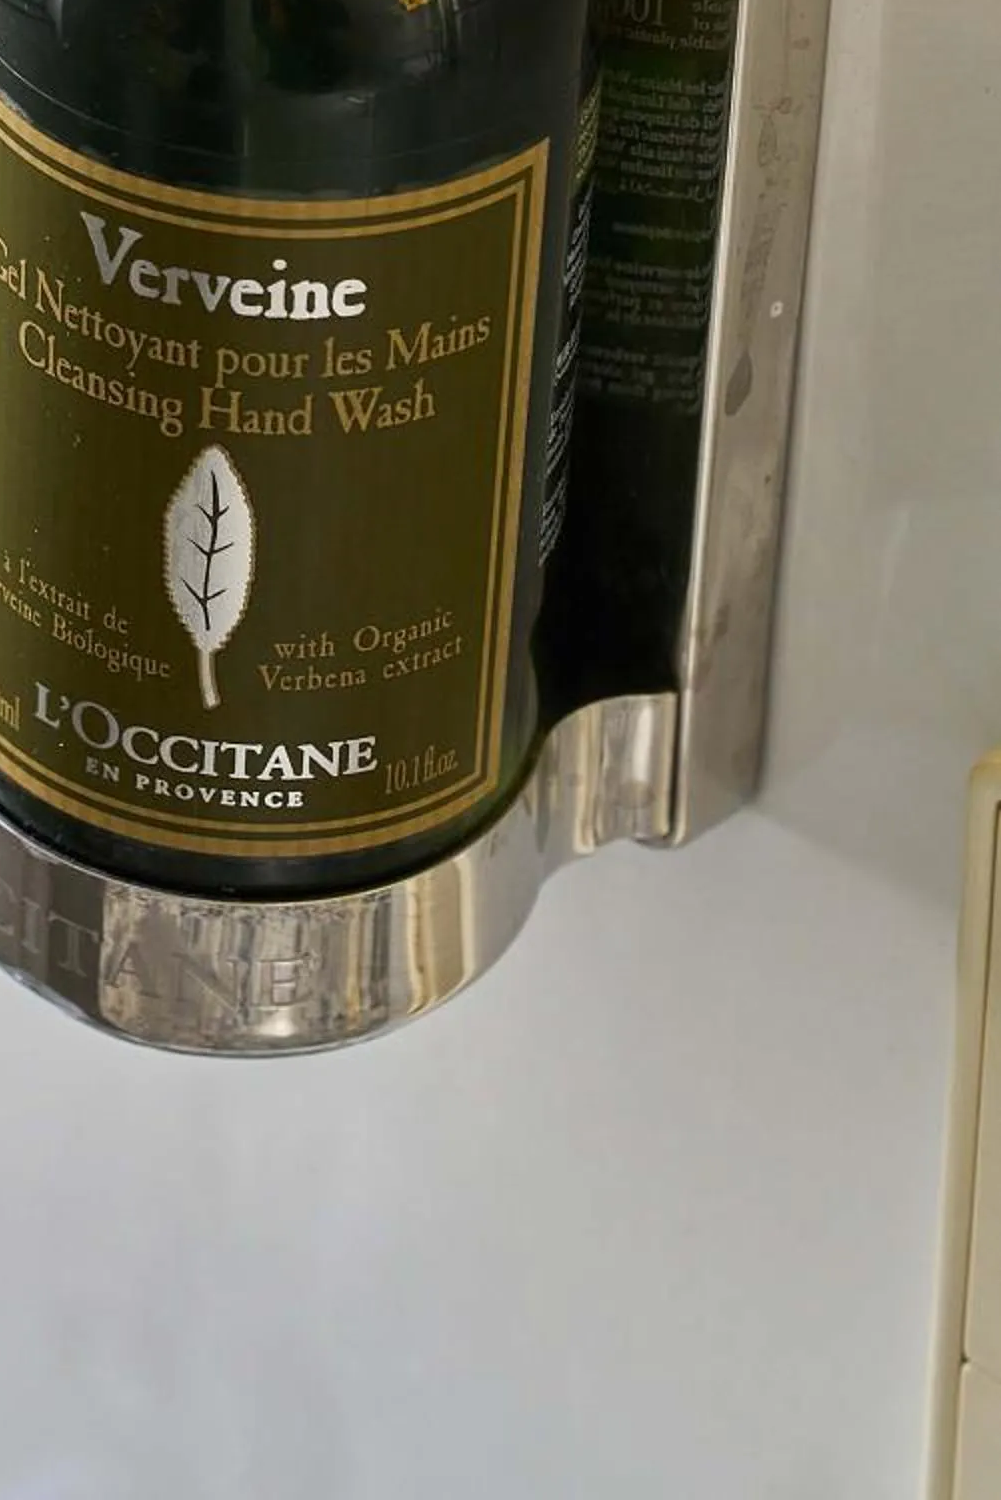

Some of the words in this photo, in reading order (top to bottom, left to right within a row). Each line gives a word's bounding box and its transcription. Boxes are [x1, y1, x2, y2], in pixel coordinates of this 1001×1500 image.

[79, 211, 368, 321] Verveine
[35, 267, 201, 371] Nettoyant
[216, 347, 310, 389] pour
[325, 337, 373, 379] les
[386, 314, 491, 372] Mains
[18, 320, 184, 438] Cleansing
[199, 386, 314, 437] Hand
[328, 379, 437, 435] Wash
[18, 558, 92, 623] l'extrait
[103, 605, 129, 636] de
[274, 635, 336, 661] with
[353, 607, 455, 657] Organic
[51, 612, 172, 681] Biologique
[257, 661, 367, 693] Verbena
[382, 635, 463, 681] extract
[32, 681, 379, 783] L'OCCITANE
[85, 756, 120, 785] EN
[134, 772, 305, 809] PROVENCE
